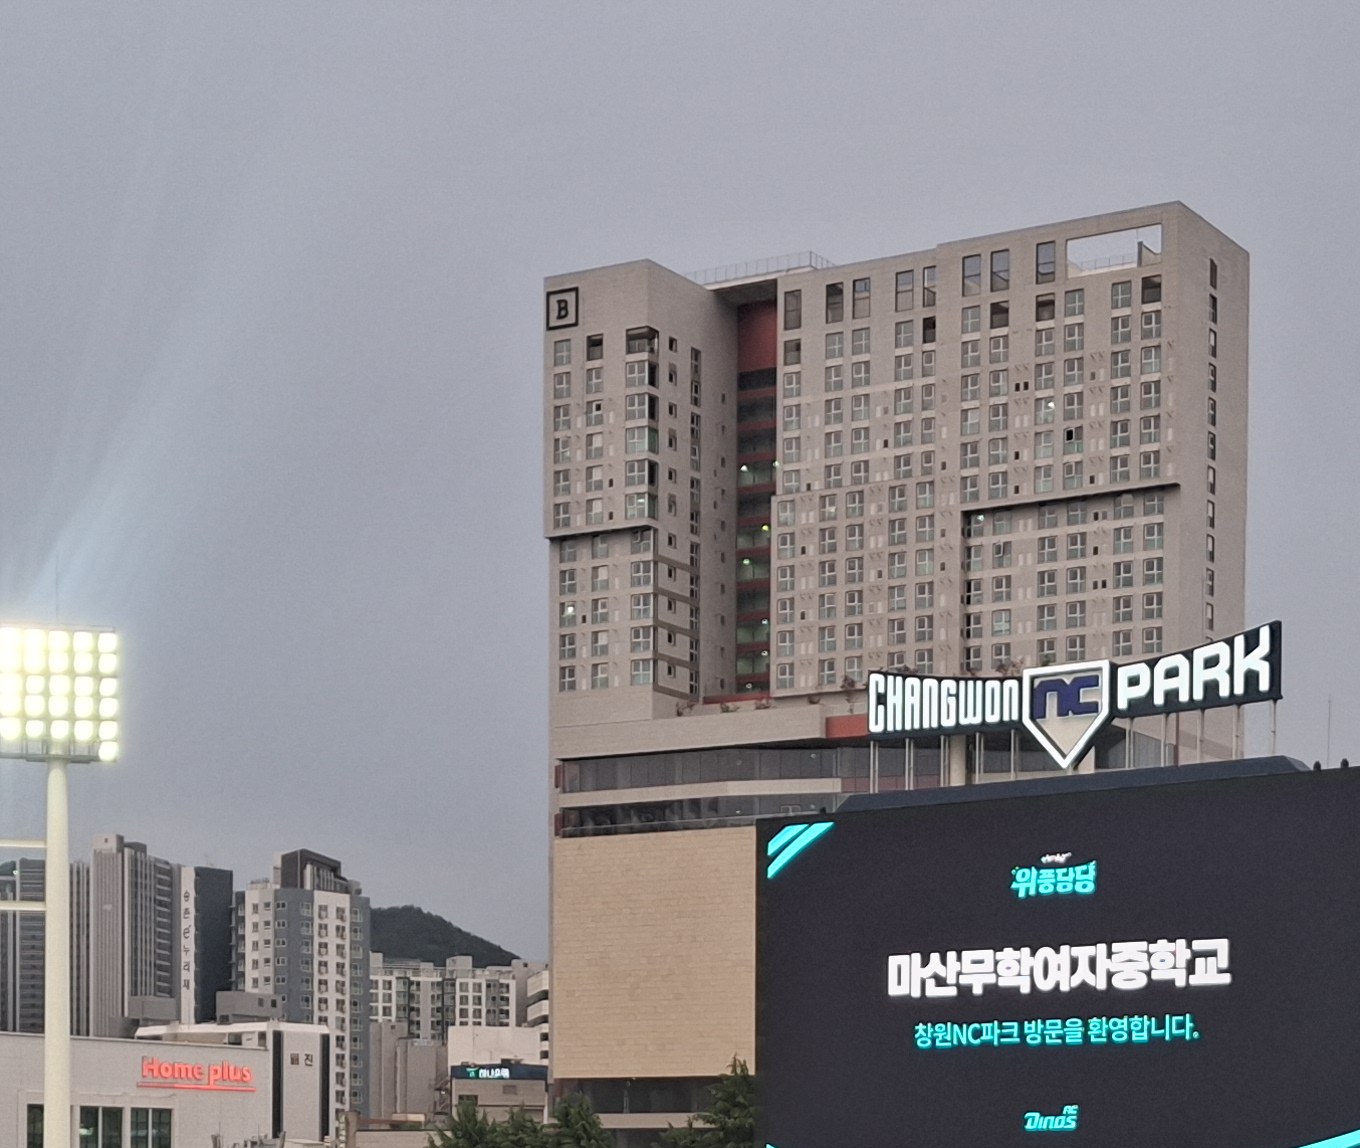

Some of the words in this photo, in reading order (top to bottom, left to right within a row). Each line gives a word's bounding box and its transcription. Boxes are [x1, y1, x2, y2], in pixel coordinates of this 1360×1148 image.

[555, 297, 570, 321] B
[869, 672, 1019, 734] CHANGWON
[1117, 625, 1271, 712] PARK
[1010, 860, 1097, 898] 위풍당당
[887, 938, 1232, 997] 마산무학여자중학교
[914, 1020, 1020, 1047] 창원NC파크
[1023, 1017, 1084, 1045] 방문을
[1088, 1013, 1200, 1044] 환영합니다.
[142, 1057, 203, 1080] Home
[209, 1060, 252, 1085] plus
